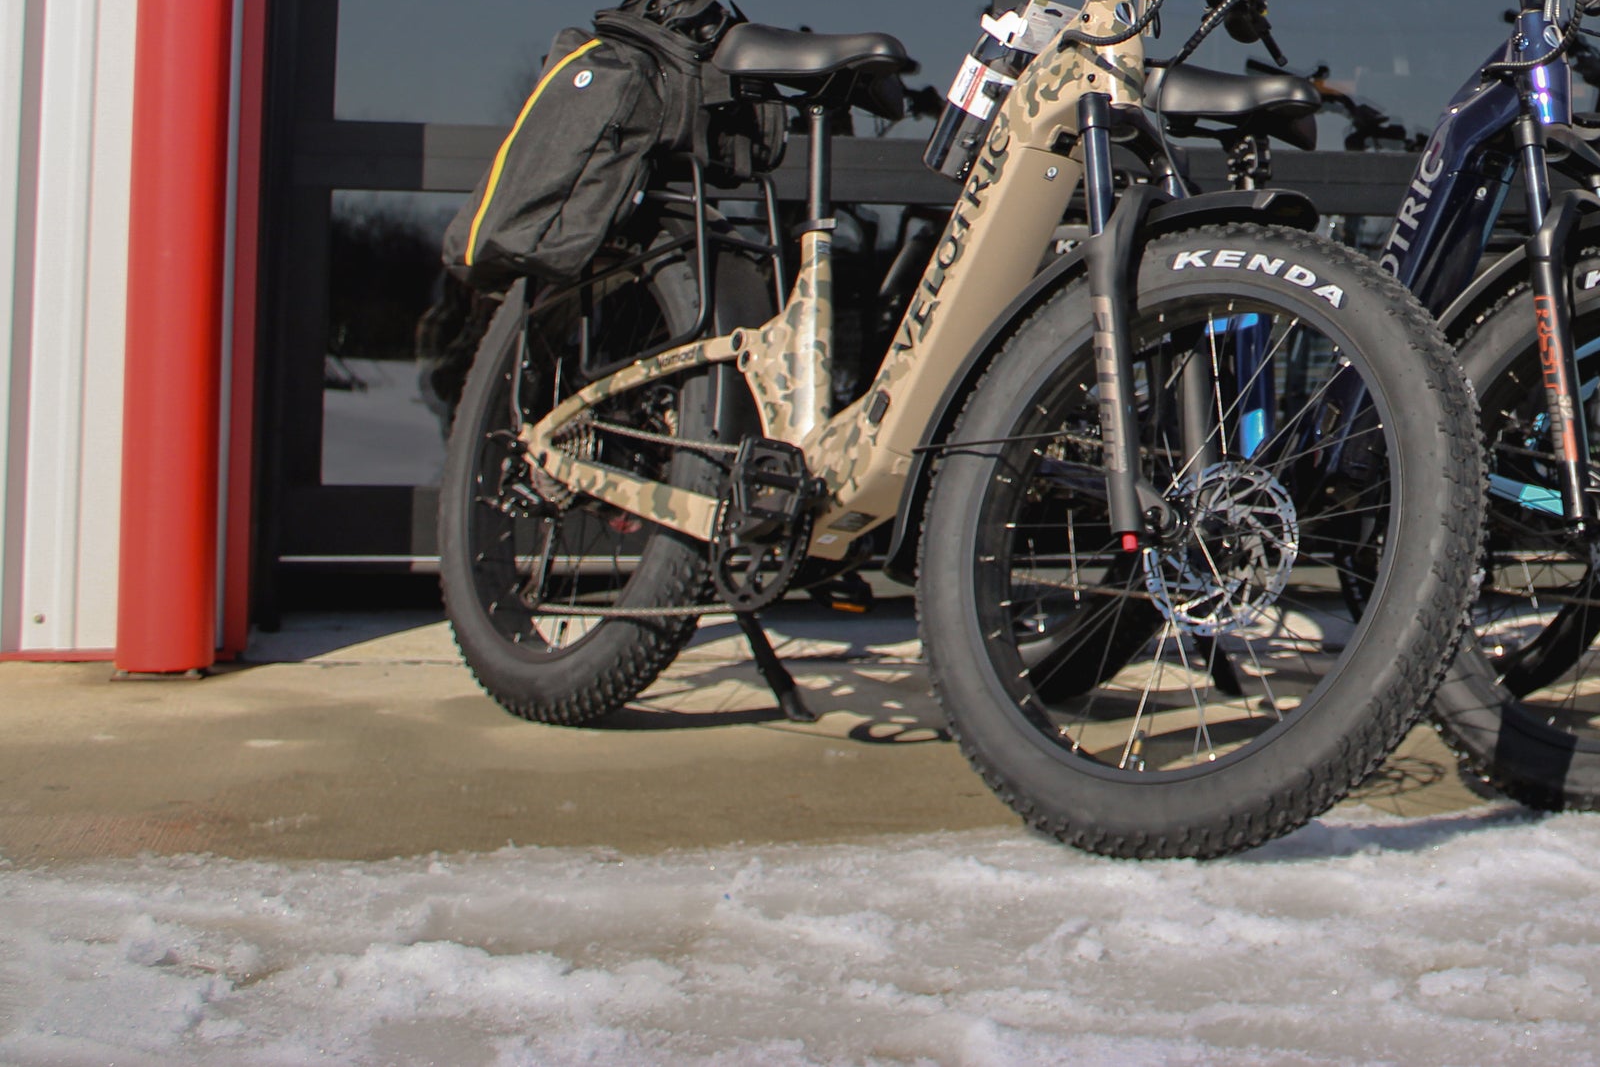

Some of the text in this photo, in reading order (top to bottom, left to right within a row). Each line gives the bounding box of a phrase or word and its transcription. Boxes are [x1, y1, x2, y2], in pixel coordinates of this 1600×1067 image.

[893, 125, 1010, 352] VELOTRIC
[1380, 149, 1444, 278] OTRIC
[1172, 249, 1344, 309] KENDA
